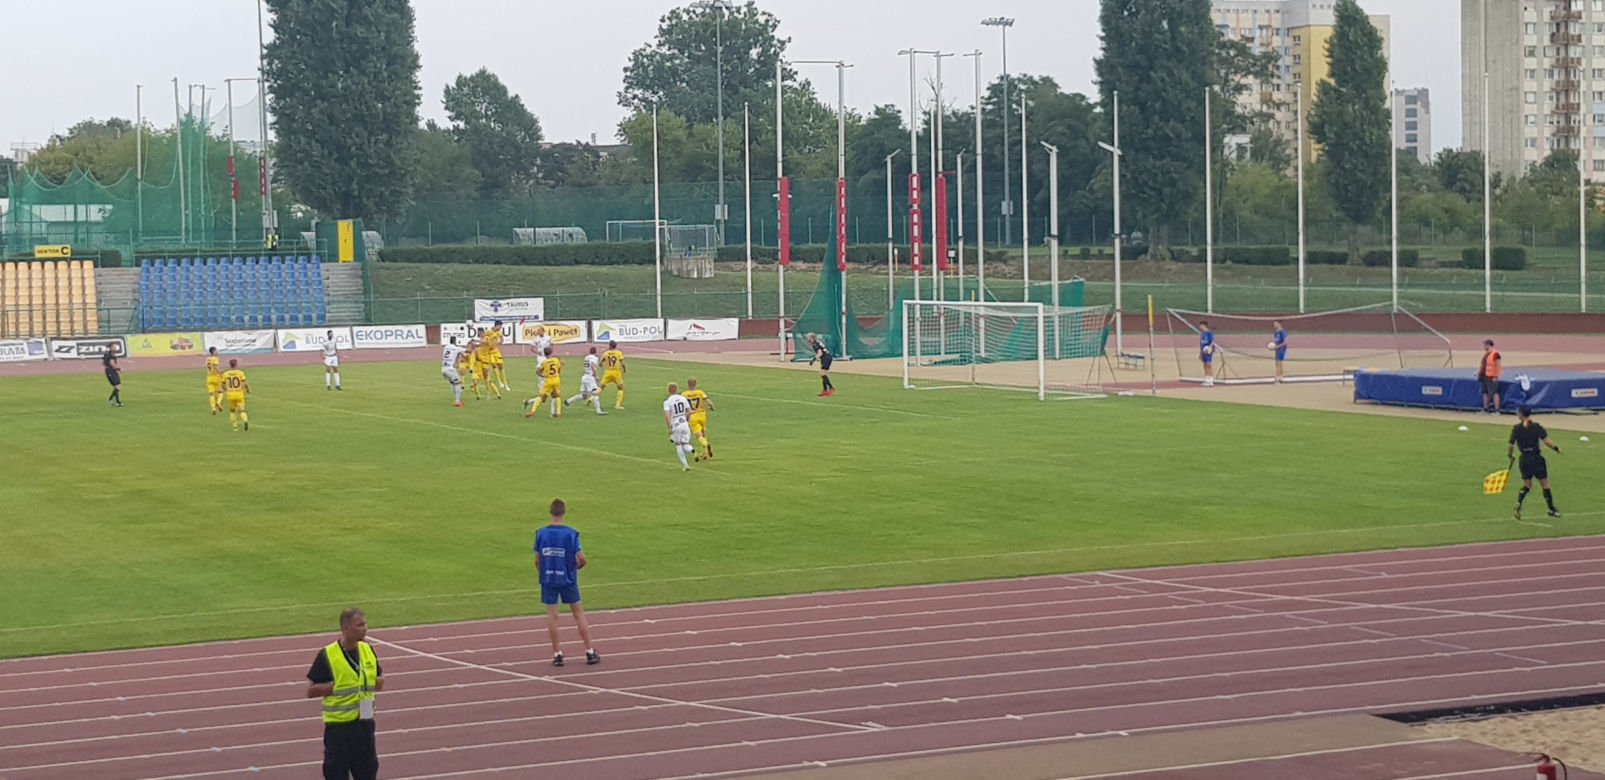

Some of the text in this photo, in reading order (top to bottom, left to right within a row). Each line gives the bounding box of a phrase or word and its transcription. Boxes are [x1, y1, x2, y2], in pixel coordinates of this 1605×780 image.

[61, 246, 69, 255] C
[355, 329, 424, 341] EKOPRAL
[619, 326, 663, 336] BUD-POL
[607, 355, 618, 367] 19
[549, 363, 557, 376] 5
[226, 376, 241, 389] 10
[673, 401, 685, 415] 10
[687, 397, 700, 410] 17
